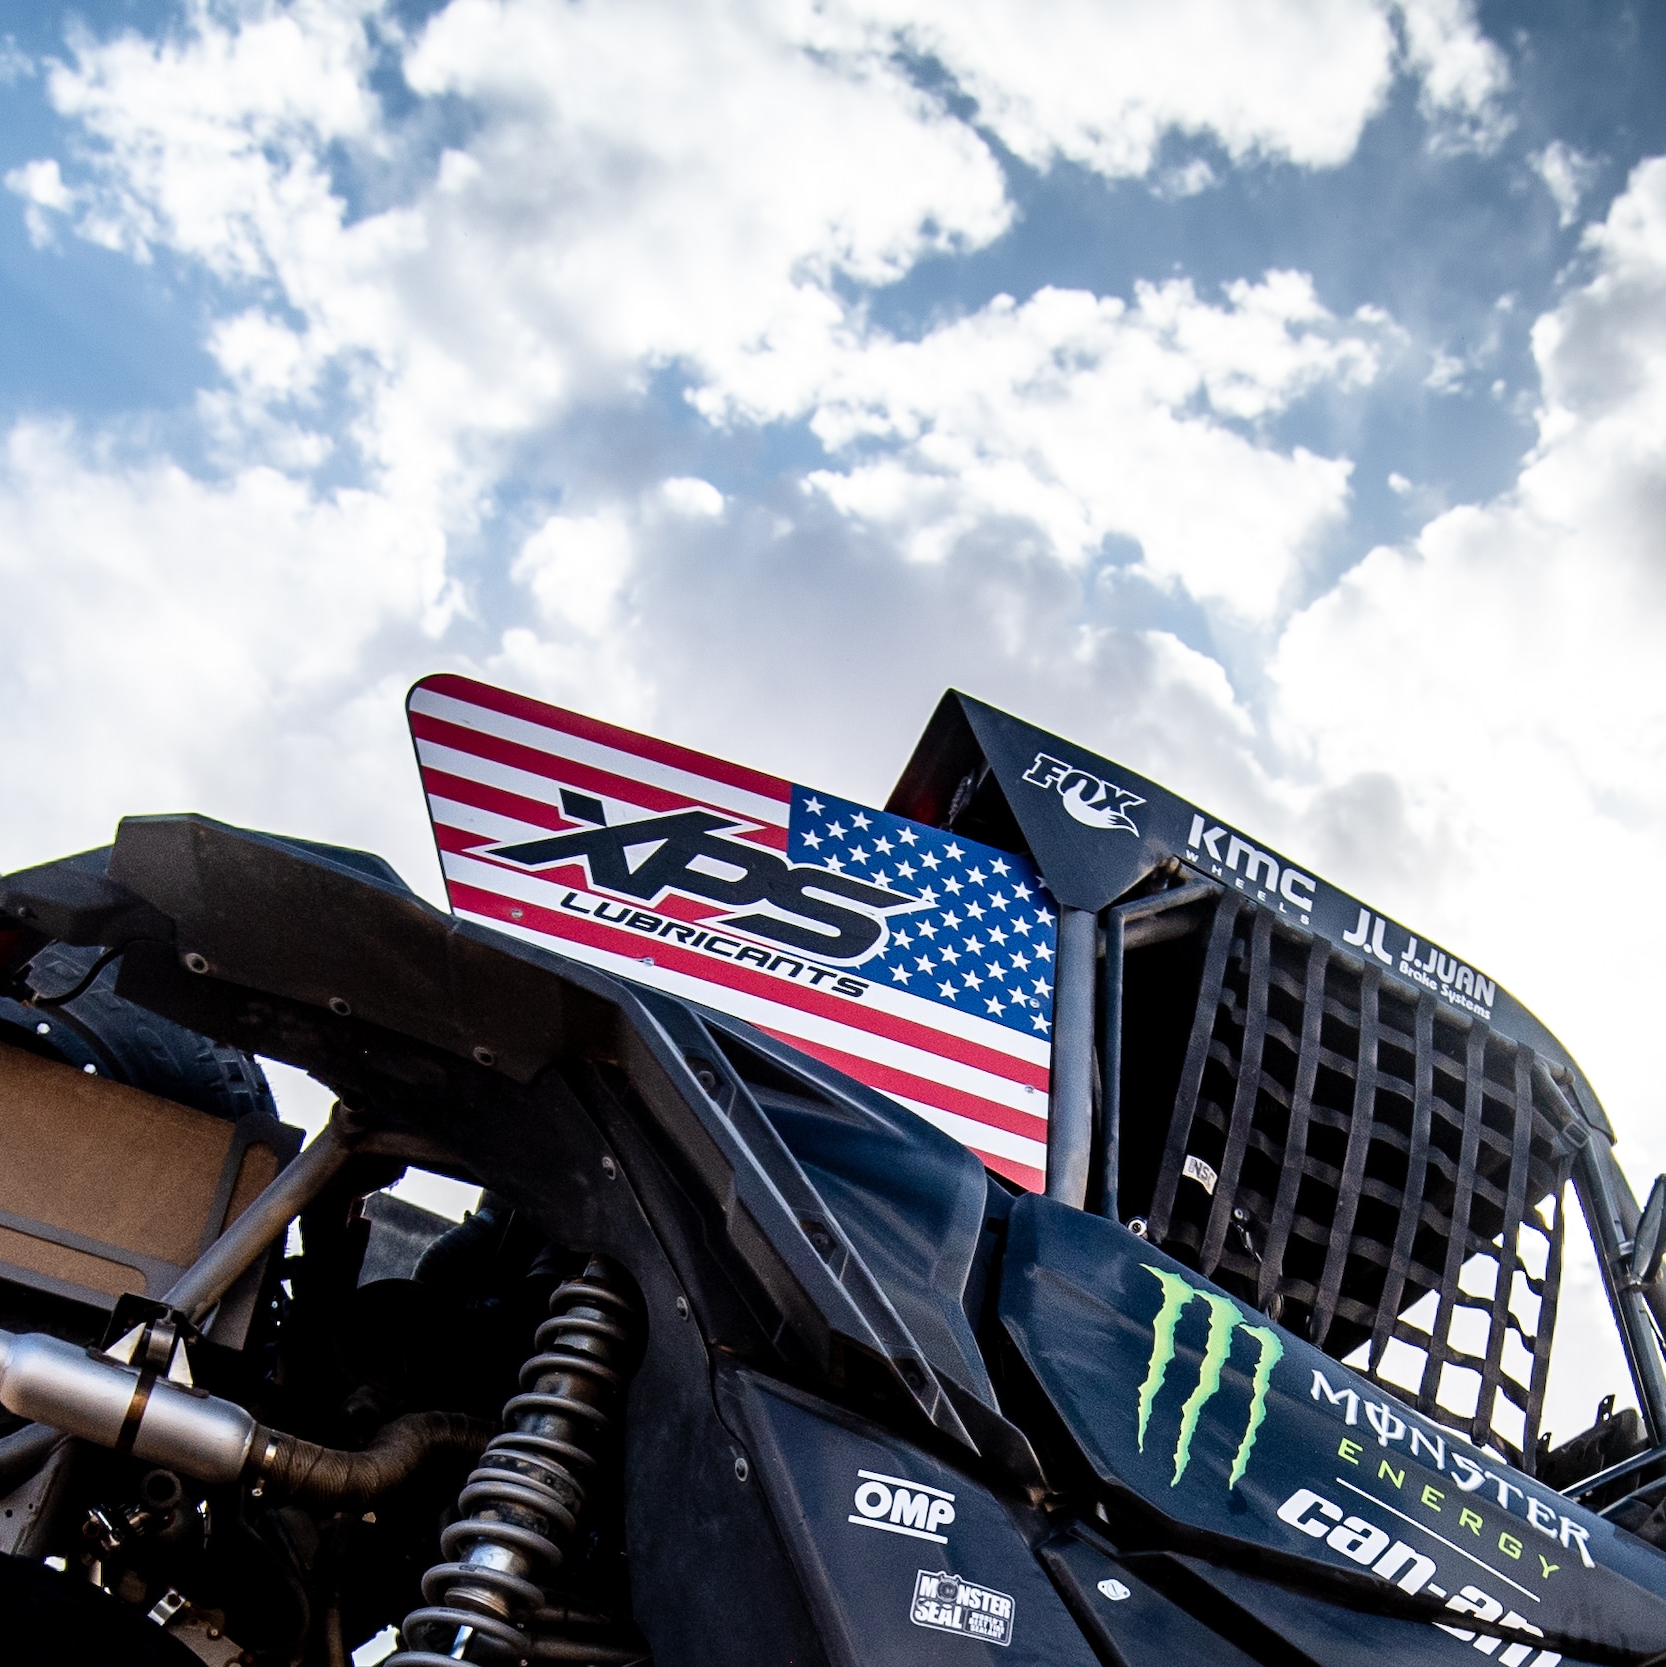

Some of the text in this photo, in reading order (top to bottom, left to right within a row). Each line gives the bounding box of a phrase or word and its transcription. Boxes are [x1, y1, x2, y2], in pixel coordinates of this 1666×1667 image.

[1022, 752, 1147, 828] FOX
[483, 787, 923, 960] XPS
[1185, 849, 1311, 926] WHEELS
[559, 892, 870, 998] LUBRICANTS
[1401, 936, 1496, 1007] J.JUAN
[1398, 960, 1491, 1020] Brake Systems
[1310, 1368, 1596, 1568] MONSTER
[854, 1481, 956, 1532] OMP
[1337, 1437, 1560, 1579] ENERGY
[915, 1600, 963, 1629] SEAL
